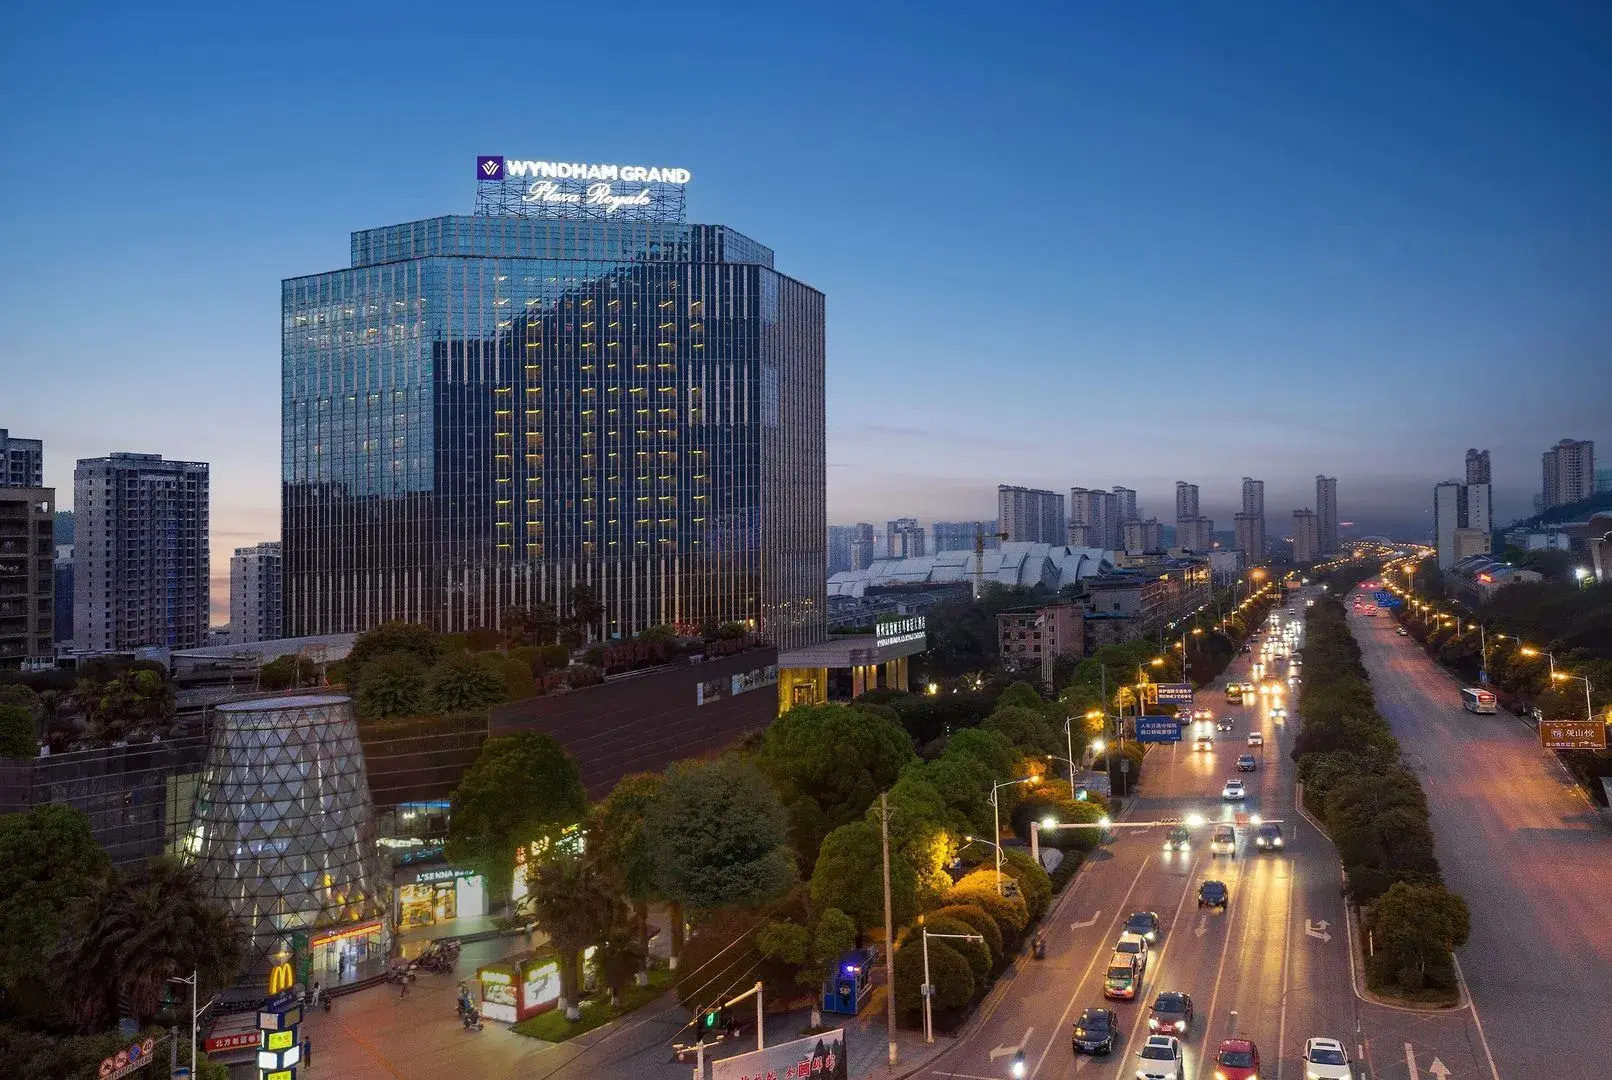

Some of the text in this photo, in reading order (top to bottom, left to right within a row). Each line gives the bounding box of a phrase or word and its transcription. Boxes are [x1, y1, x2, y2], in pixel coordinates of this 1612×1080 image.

[507, 159, 691, 184] WYNDHAM GRAND
[522, 180, 651, 213] Plaza Royale
[144, 1042, 152, 1050] 40
